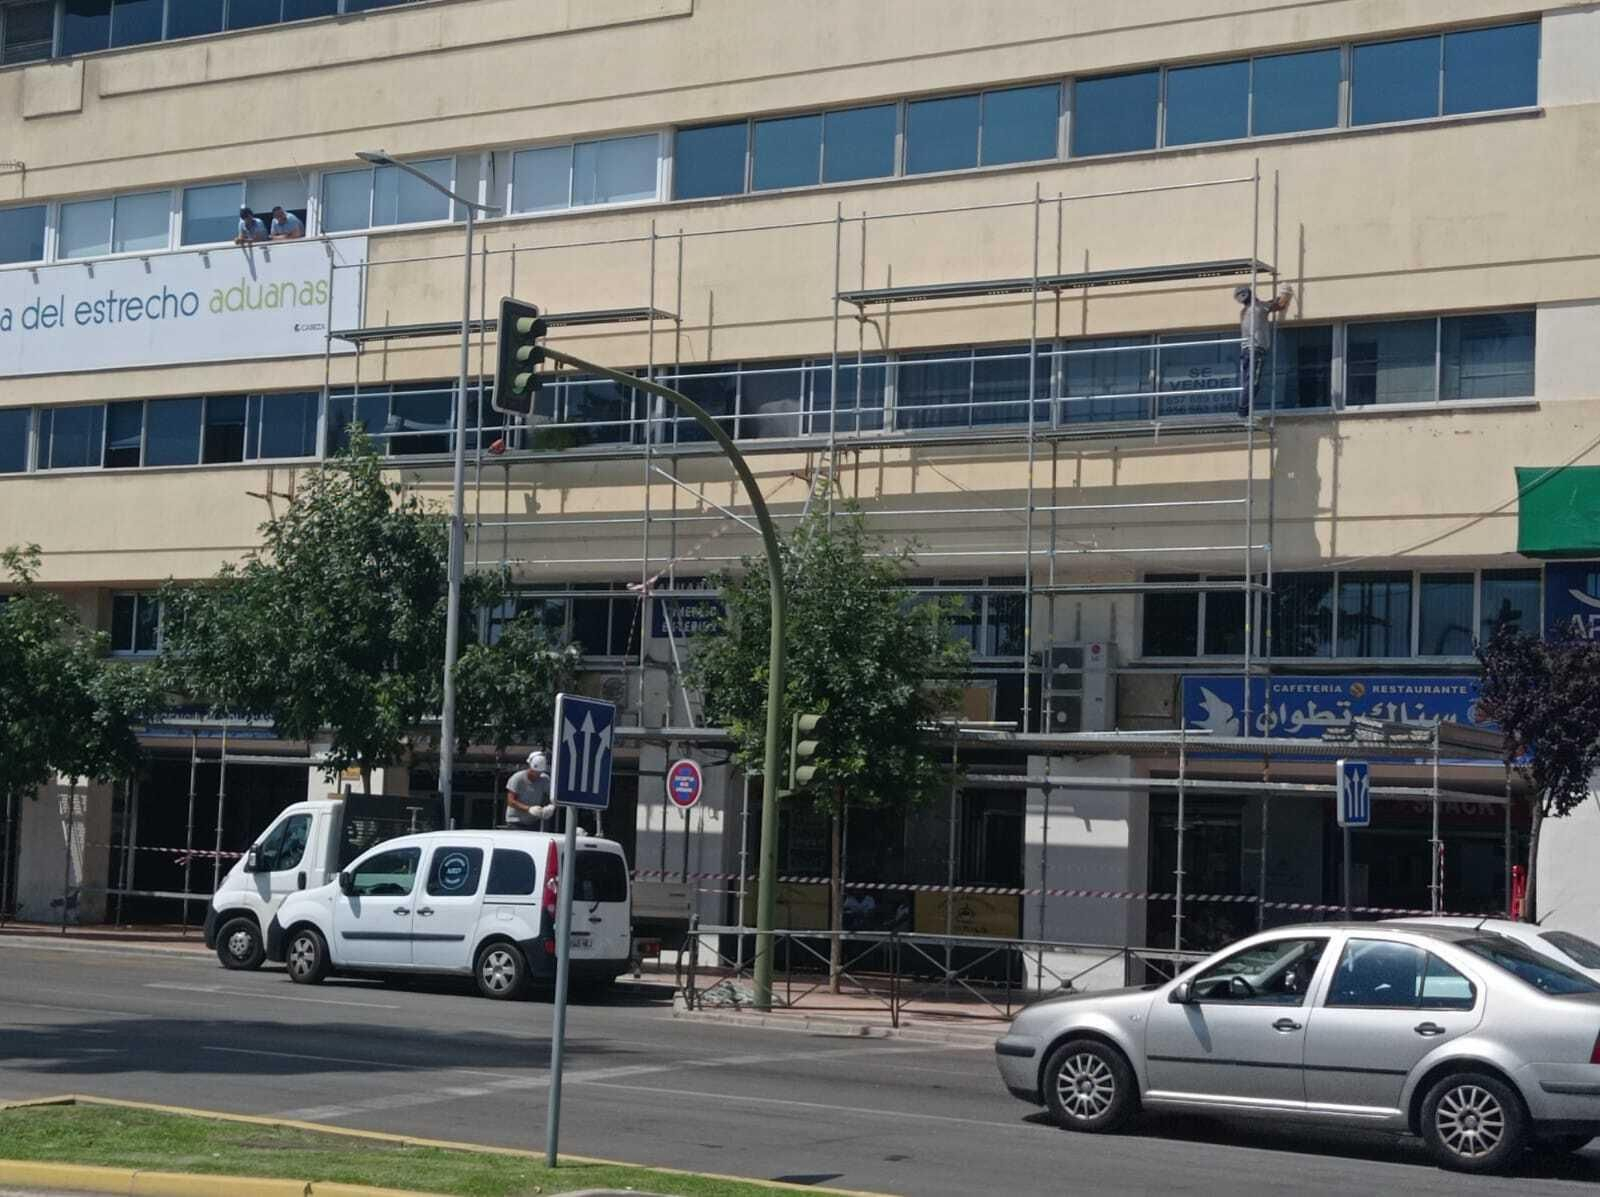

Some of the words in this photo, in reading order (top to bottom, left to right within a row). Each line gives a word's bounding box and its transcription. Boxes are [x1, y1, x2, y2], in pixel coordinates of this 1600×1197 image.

[21, 297, 64, 330] del
[75, 285, 199, 325] estrecho
[209, 277, 328, 314] aduanas
[1189, 367, 1212, 378] SE
[1169, 379, 1232, 389] VENDE
[1372, 685, 1467, 694] RESTAURANTE
